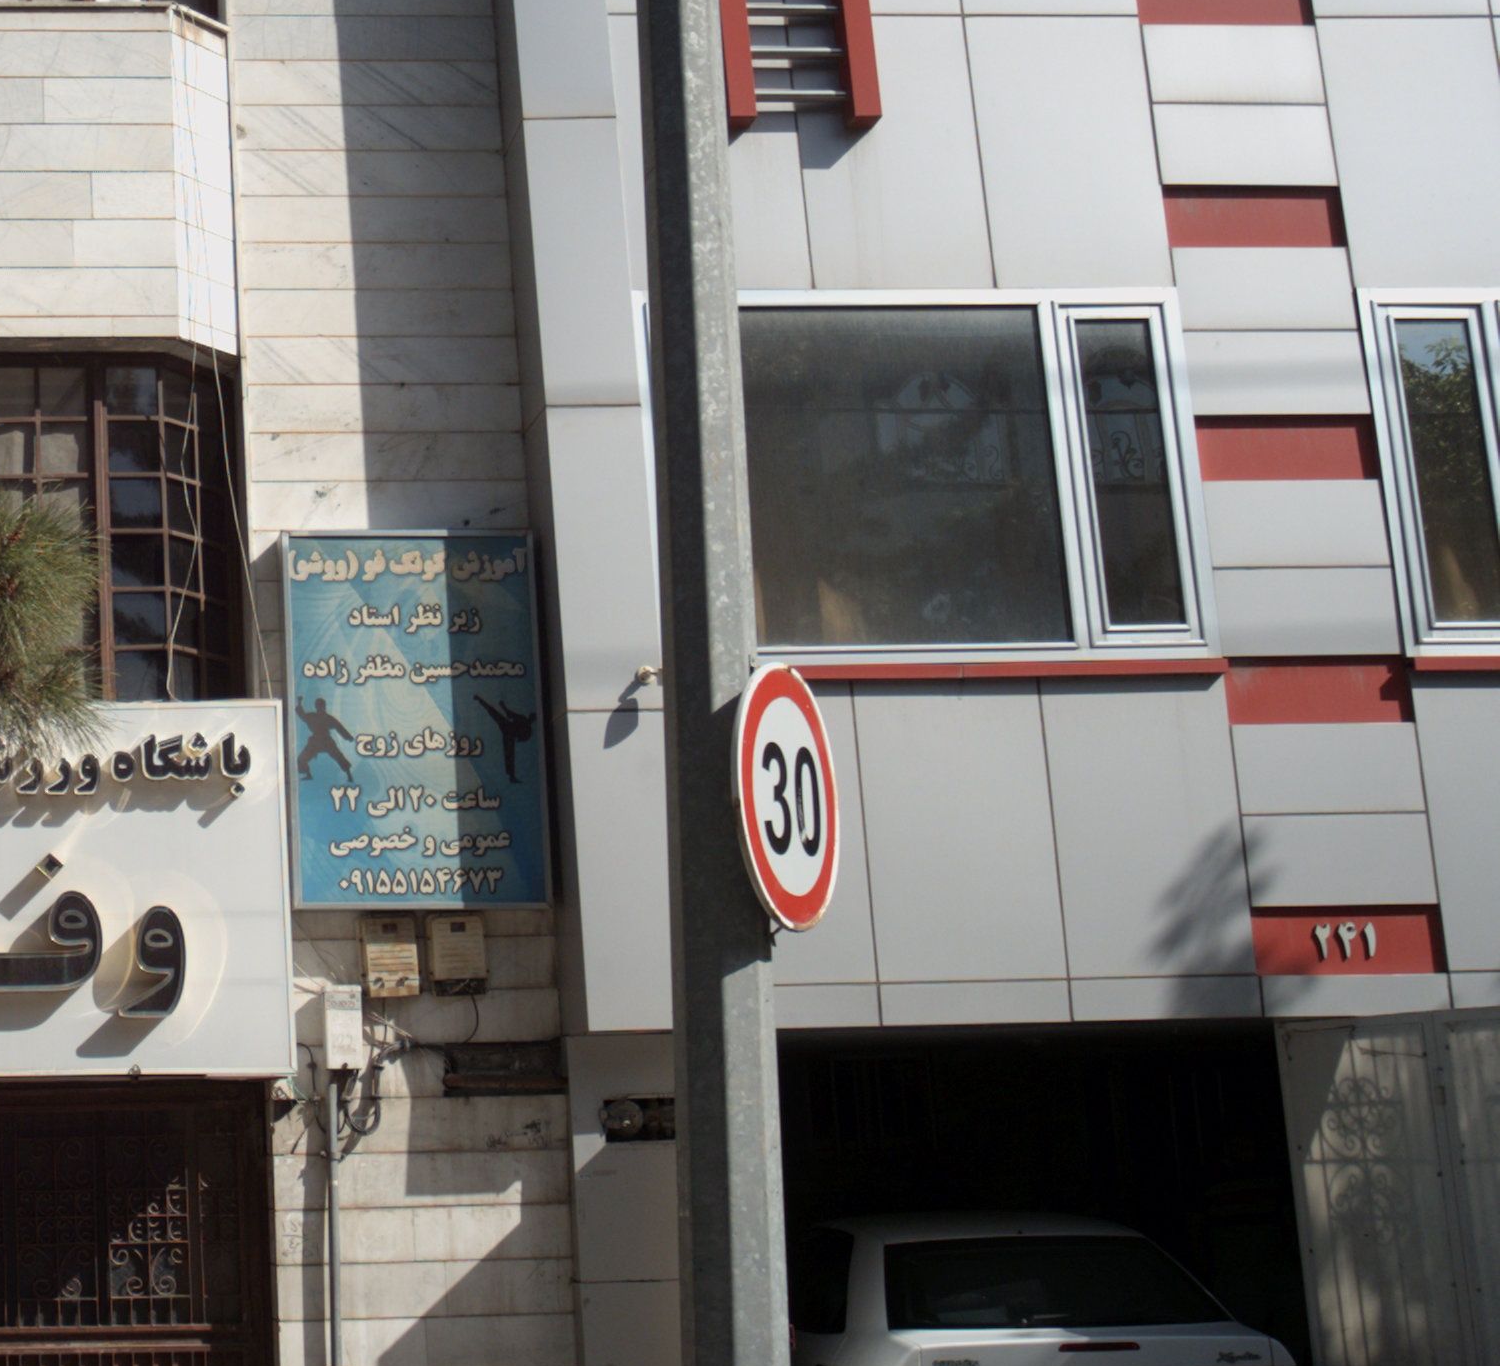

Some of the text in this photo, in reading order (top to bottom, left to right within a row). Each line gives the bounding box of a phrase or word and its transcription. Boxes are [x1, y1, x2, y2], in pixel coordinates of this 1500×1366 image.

[362, 549, 386, 582] فو
[452, 547, 526, 580] آموزش
[348, 603, 482, 633] زیر نظر استاد
[356, 727, 483, 757] روزهای زوج
[110, 731, 252, 798] باشگاه
[330, 786, 500, 817] ساعت ۲۰ الی ۲۲
[762, 741, 821, 857] 30
[330, 826, 511, 857] عمومی و خصوصی
[339, 867, 503, 895] ۰۹۱۵۵۱۵۴۶۷۳
[1314, 920, 1378, 961] ۲۴۱
